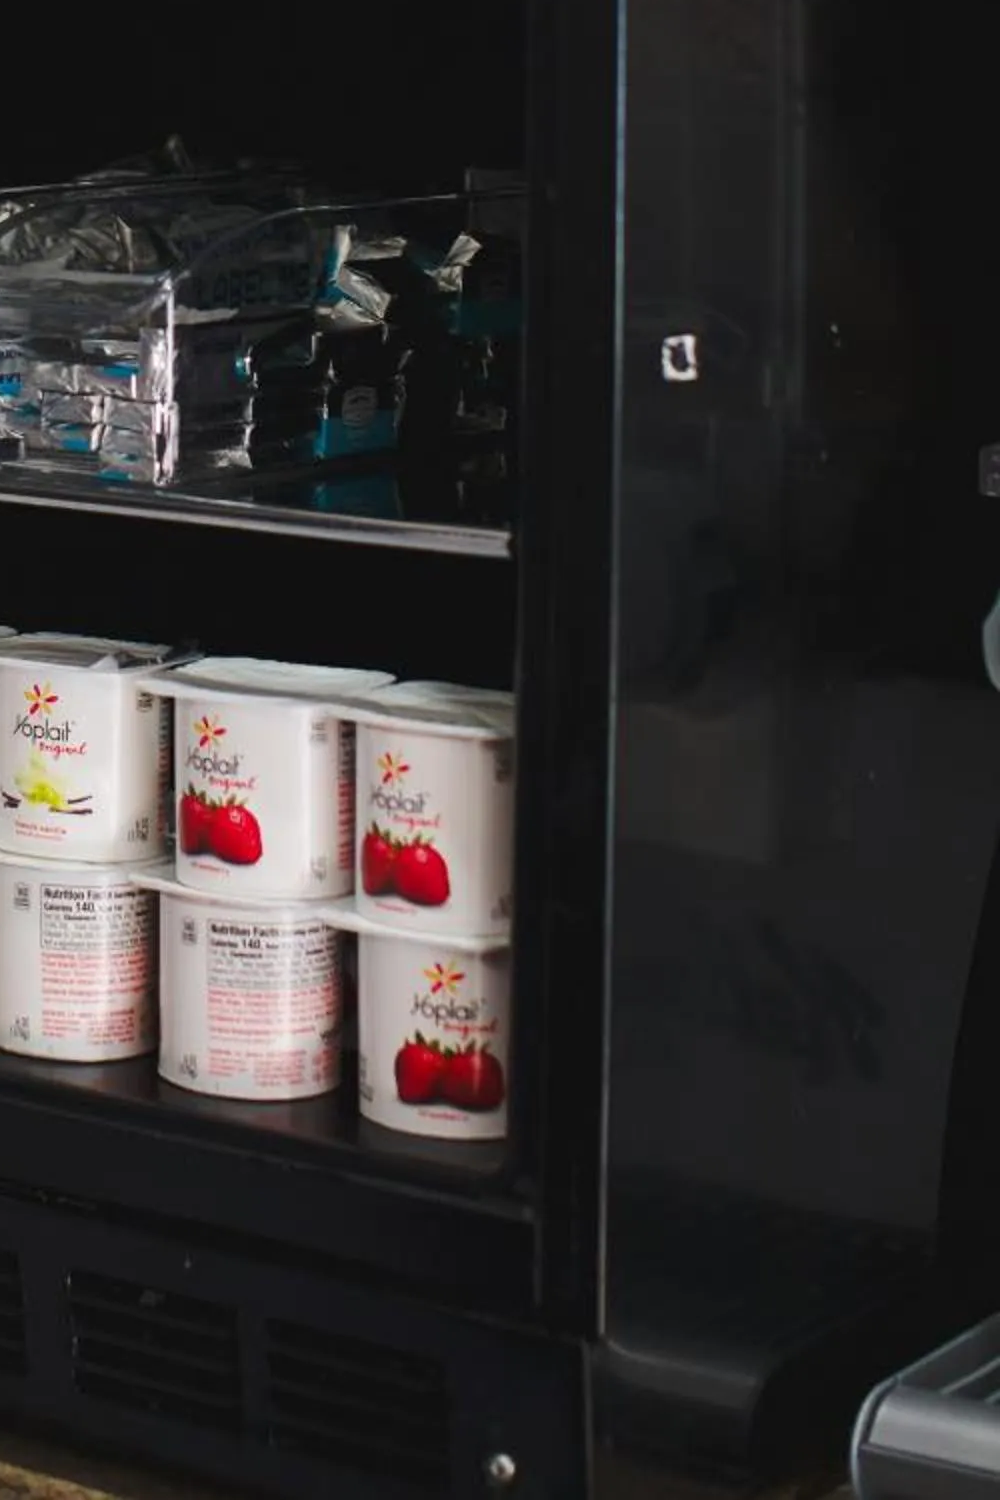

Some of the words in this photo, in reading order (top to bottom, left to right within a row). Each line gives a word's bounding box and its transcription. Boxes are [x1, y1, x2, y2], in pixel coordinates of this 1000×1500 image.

[13, 715, 72, 744] Yoplait
[185, 747, 240, 777] Yoplait
[371, 785, 426, 816] Yoplait
[410, 993, 480, 1027] Yoplait
